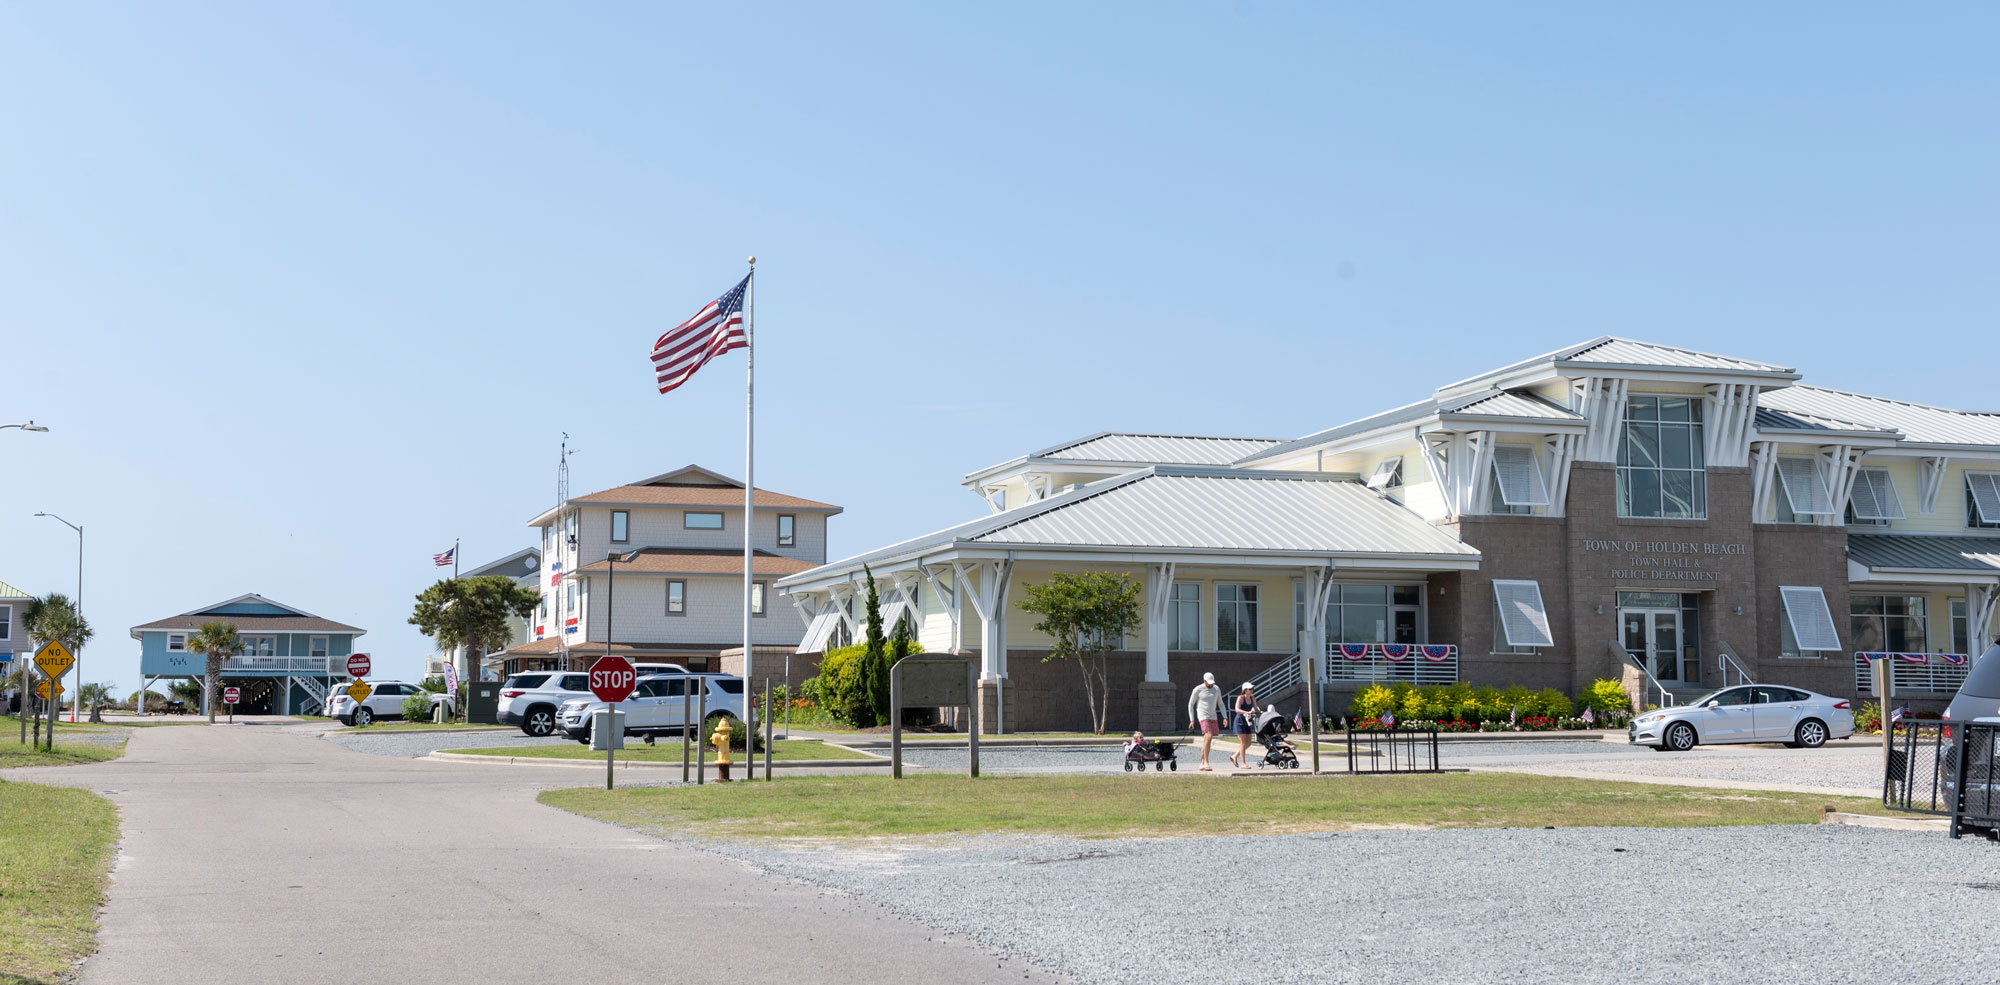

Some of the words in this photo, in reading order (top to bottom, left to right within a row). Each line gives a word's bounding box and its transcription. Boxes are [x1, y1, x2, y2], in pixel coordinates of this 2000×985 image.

[1583, 540, 1620, 552] TOWN
[1625, 541, 1641, 552] OF
[1646, 541, 1699, 554] HOLDEN
[1630, 557, 1659, 567] TOWN
[1663, 558, 1691, 568] HALL
[1694, 559, 1701, 568] &
[1611, 569, 1647, 579] POLICE
[1651, 570, 1720, 580] DEPARTMENT
[592, 670, 633, 688] STOP
